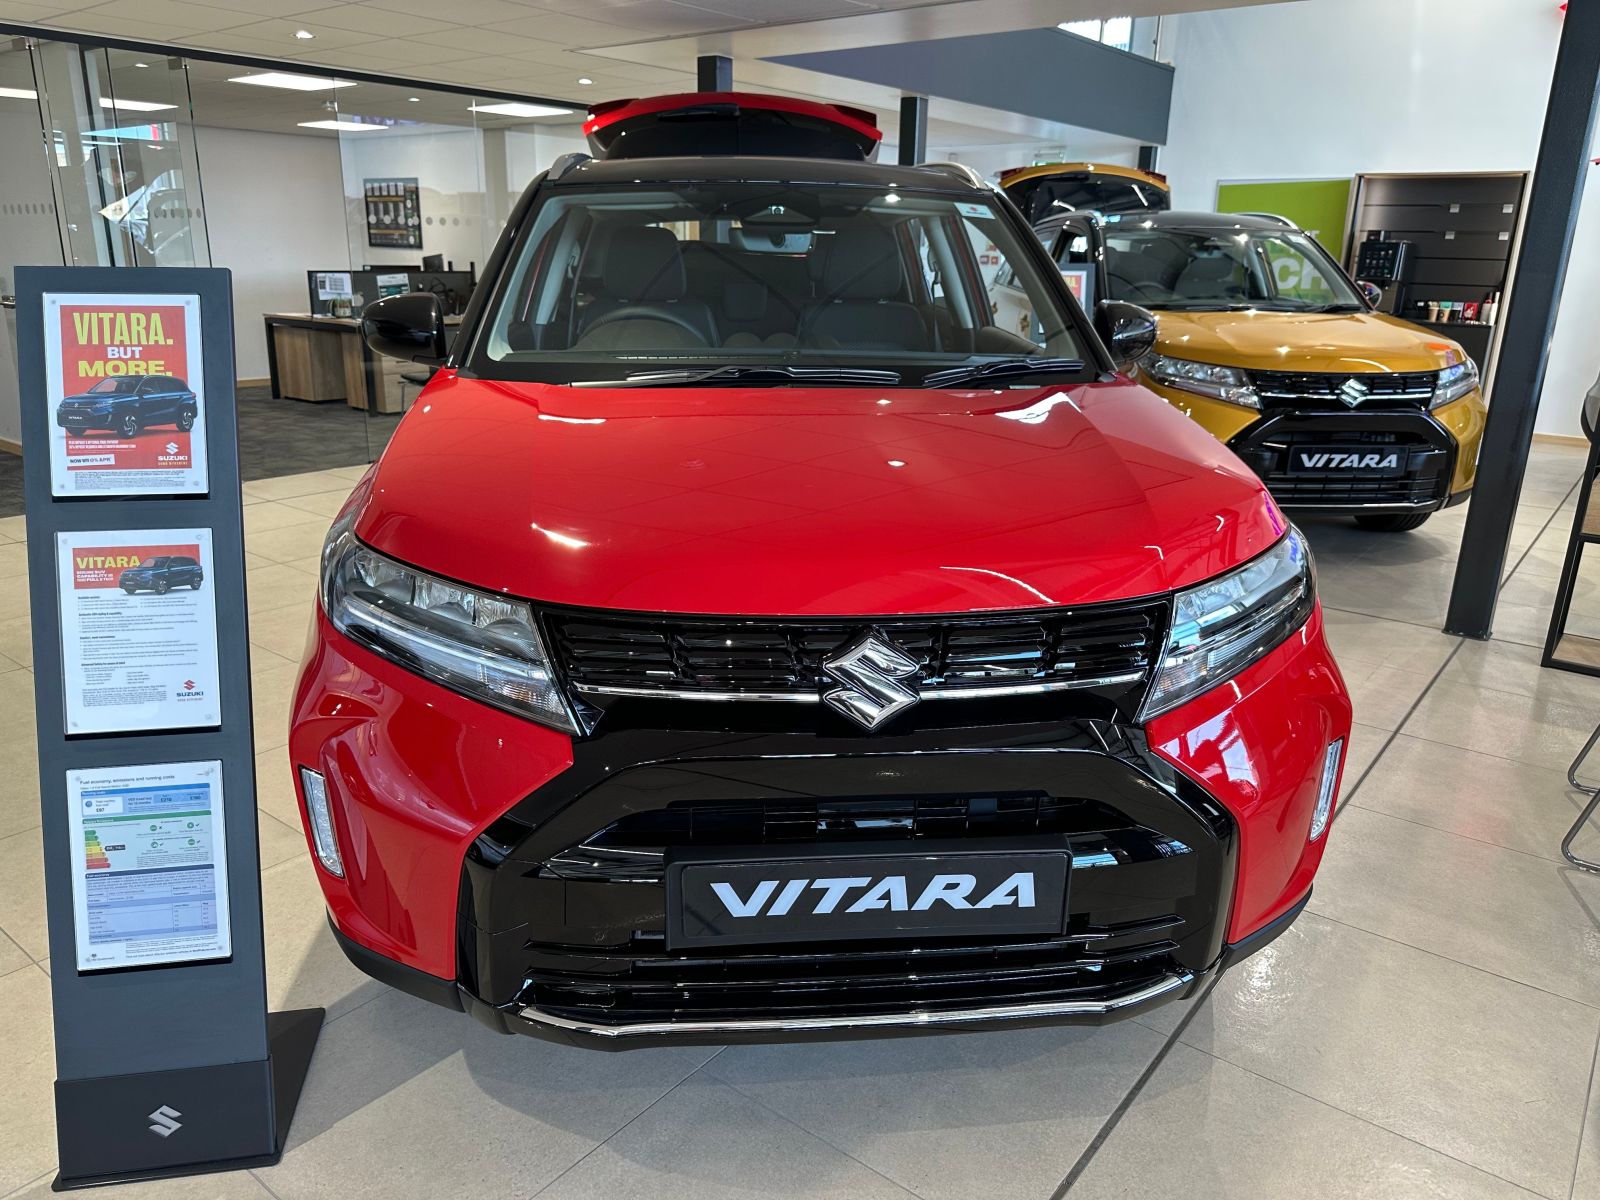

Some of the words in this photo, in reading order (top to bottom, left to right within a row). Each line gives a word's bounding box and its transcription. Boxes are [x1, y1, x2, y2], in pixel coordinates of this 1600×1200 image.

[73, 312, 174, 345] VITARA.
[107, 346, 142, 359] BUT
[78, 360, 173, 377] MORE.
[1300, 453, 1397, 468] VITARA
[76, 555, 140, 569] VITARA
[709, 872, 1036, 918] VITARA
